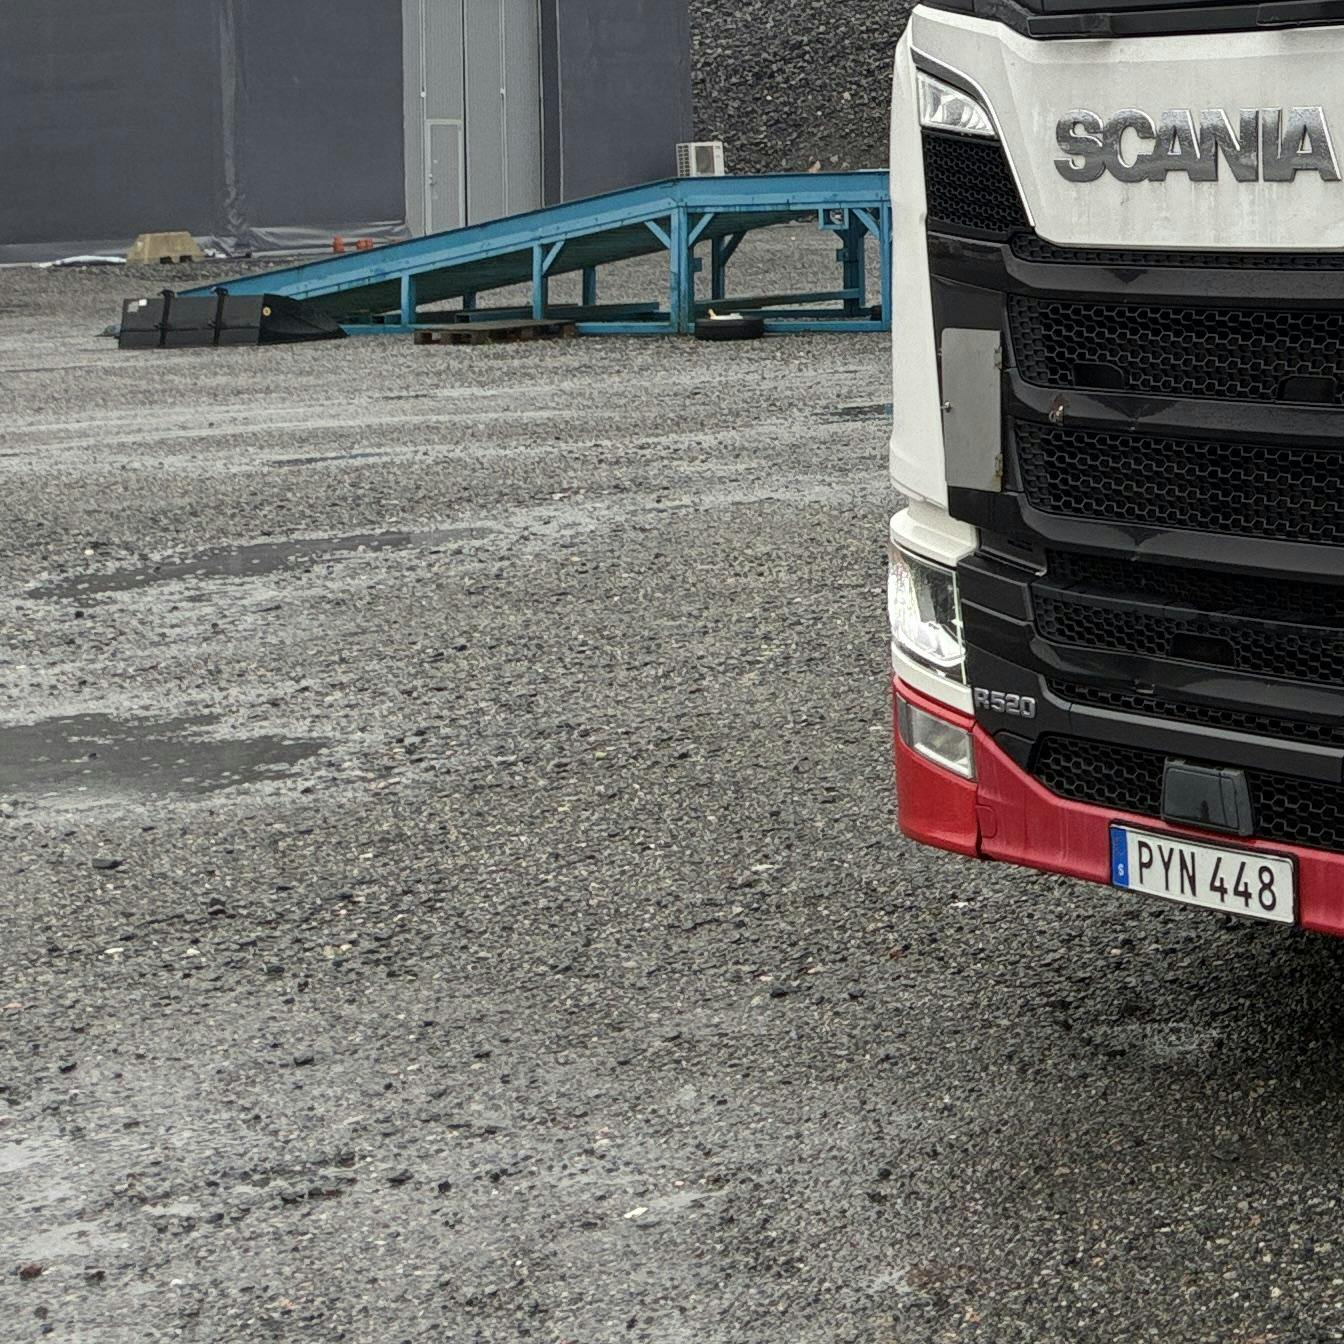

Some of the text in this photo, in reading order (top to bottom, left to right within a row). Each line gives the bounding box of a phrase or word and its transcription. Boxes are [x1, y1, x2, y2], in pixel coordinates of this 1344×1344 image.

[1053, 106, 1342, 183] SCANIA
[974, 687, 1036, 719] R520
[1137, 839, 1197, 897] PYN
[1209, 856, 1277, 911] 448
